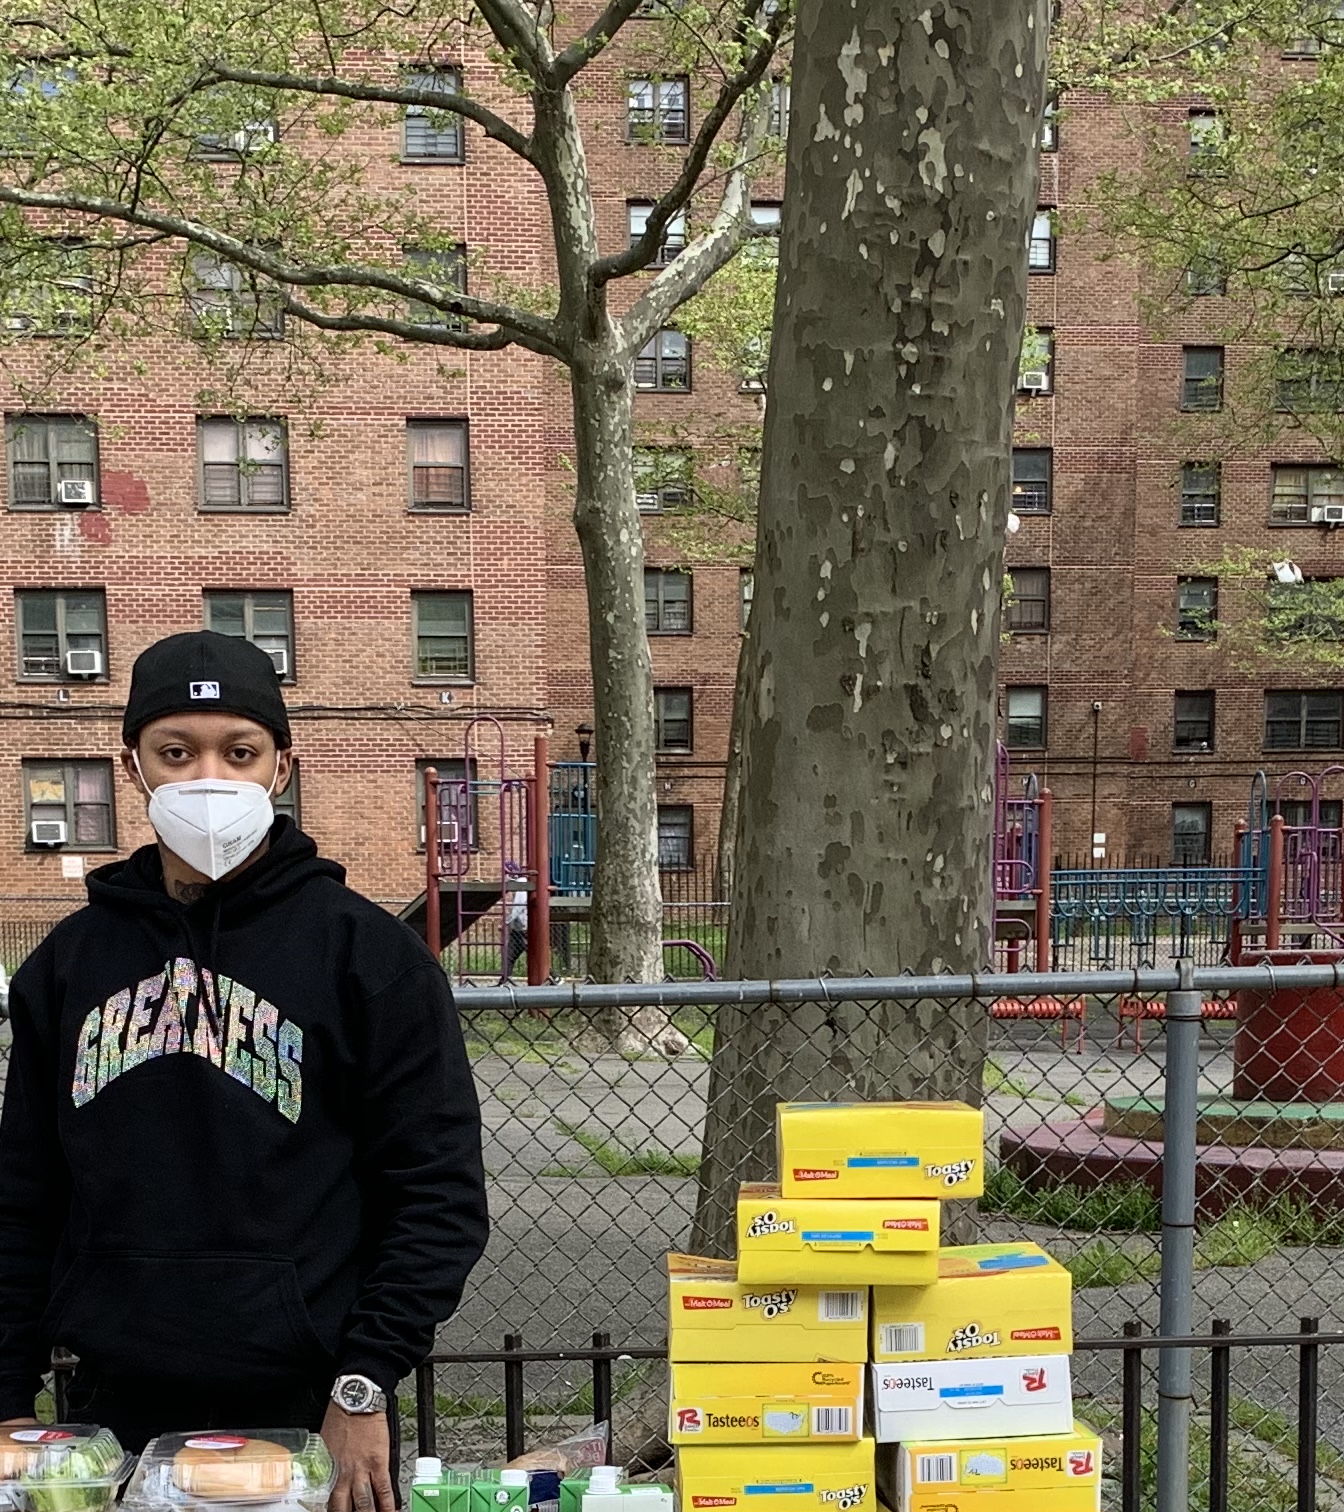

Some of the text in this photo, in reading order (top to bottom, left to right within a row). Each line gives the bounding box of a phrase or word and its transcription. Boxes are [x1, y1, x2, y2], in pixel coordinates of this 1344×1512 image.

[71, 957, 304, 1125] GREATNESS
[925, 1159, 976, 1178] Toasty
[944, 1171, 967, 1187] O's
[745, 1220, 797, 1238] Toasty
[742, 1288, 799, 1309] Toasty
[763, 1301, 789, 1319] O's
[946, 1331, 1002, 1353] Toasty
[882, 1377, 935, 1391] Tasteeos
[706, 1413, 760, 1428] Tasteeos
[1010, 1456, 1064, 1471] Tasteeos
[819, 1483, 869, 1503] Toasty
[838, 1495, 861, 1511] O's
